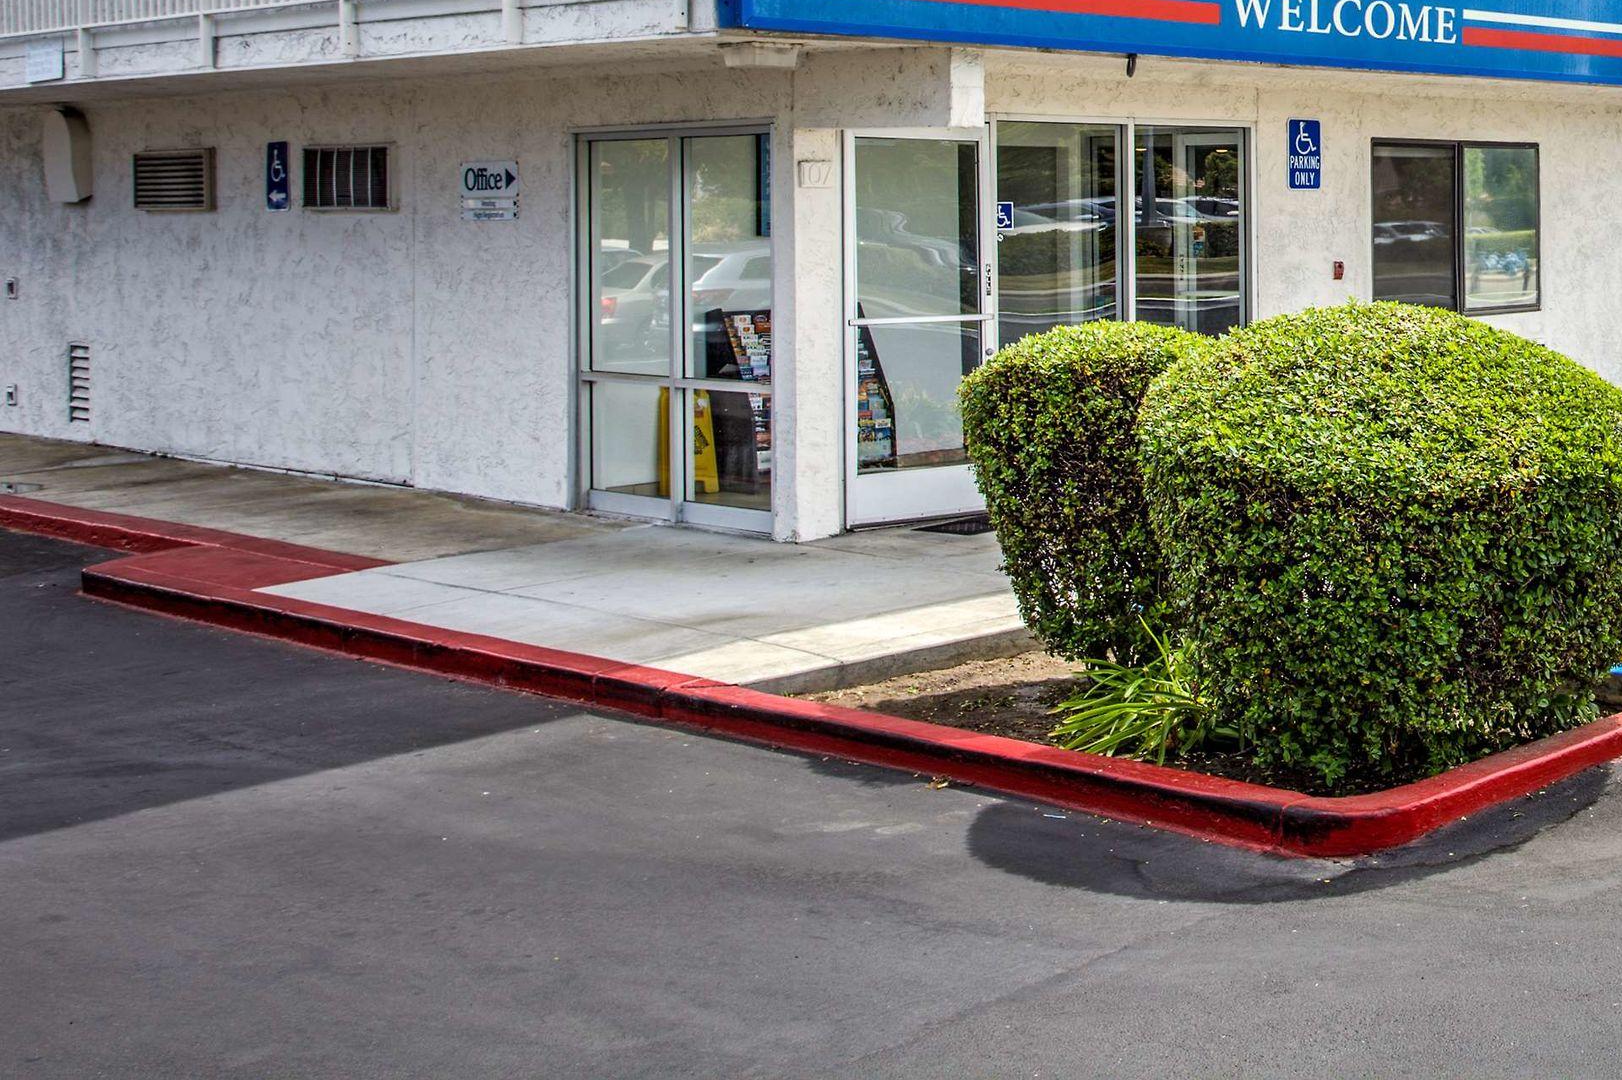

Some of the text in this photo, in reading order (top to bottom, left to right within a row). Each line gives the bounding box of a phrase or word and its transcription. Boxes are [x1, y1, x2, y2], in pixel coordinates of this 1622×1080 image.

[1290, 155, 1320, 169] PARKING
[464, 167, 503, 191] Office
[1295, 172, 1315, 186] ONLY
